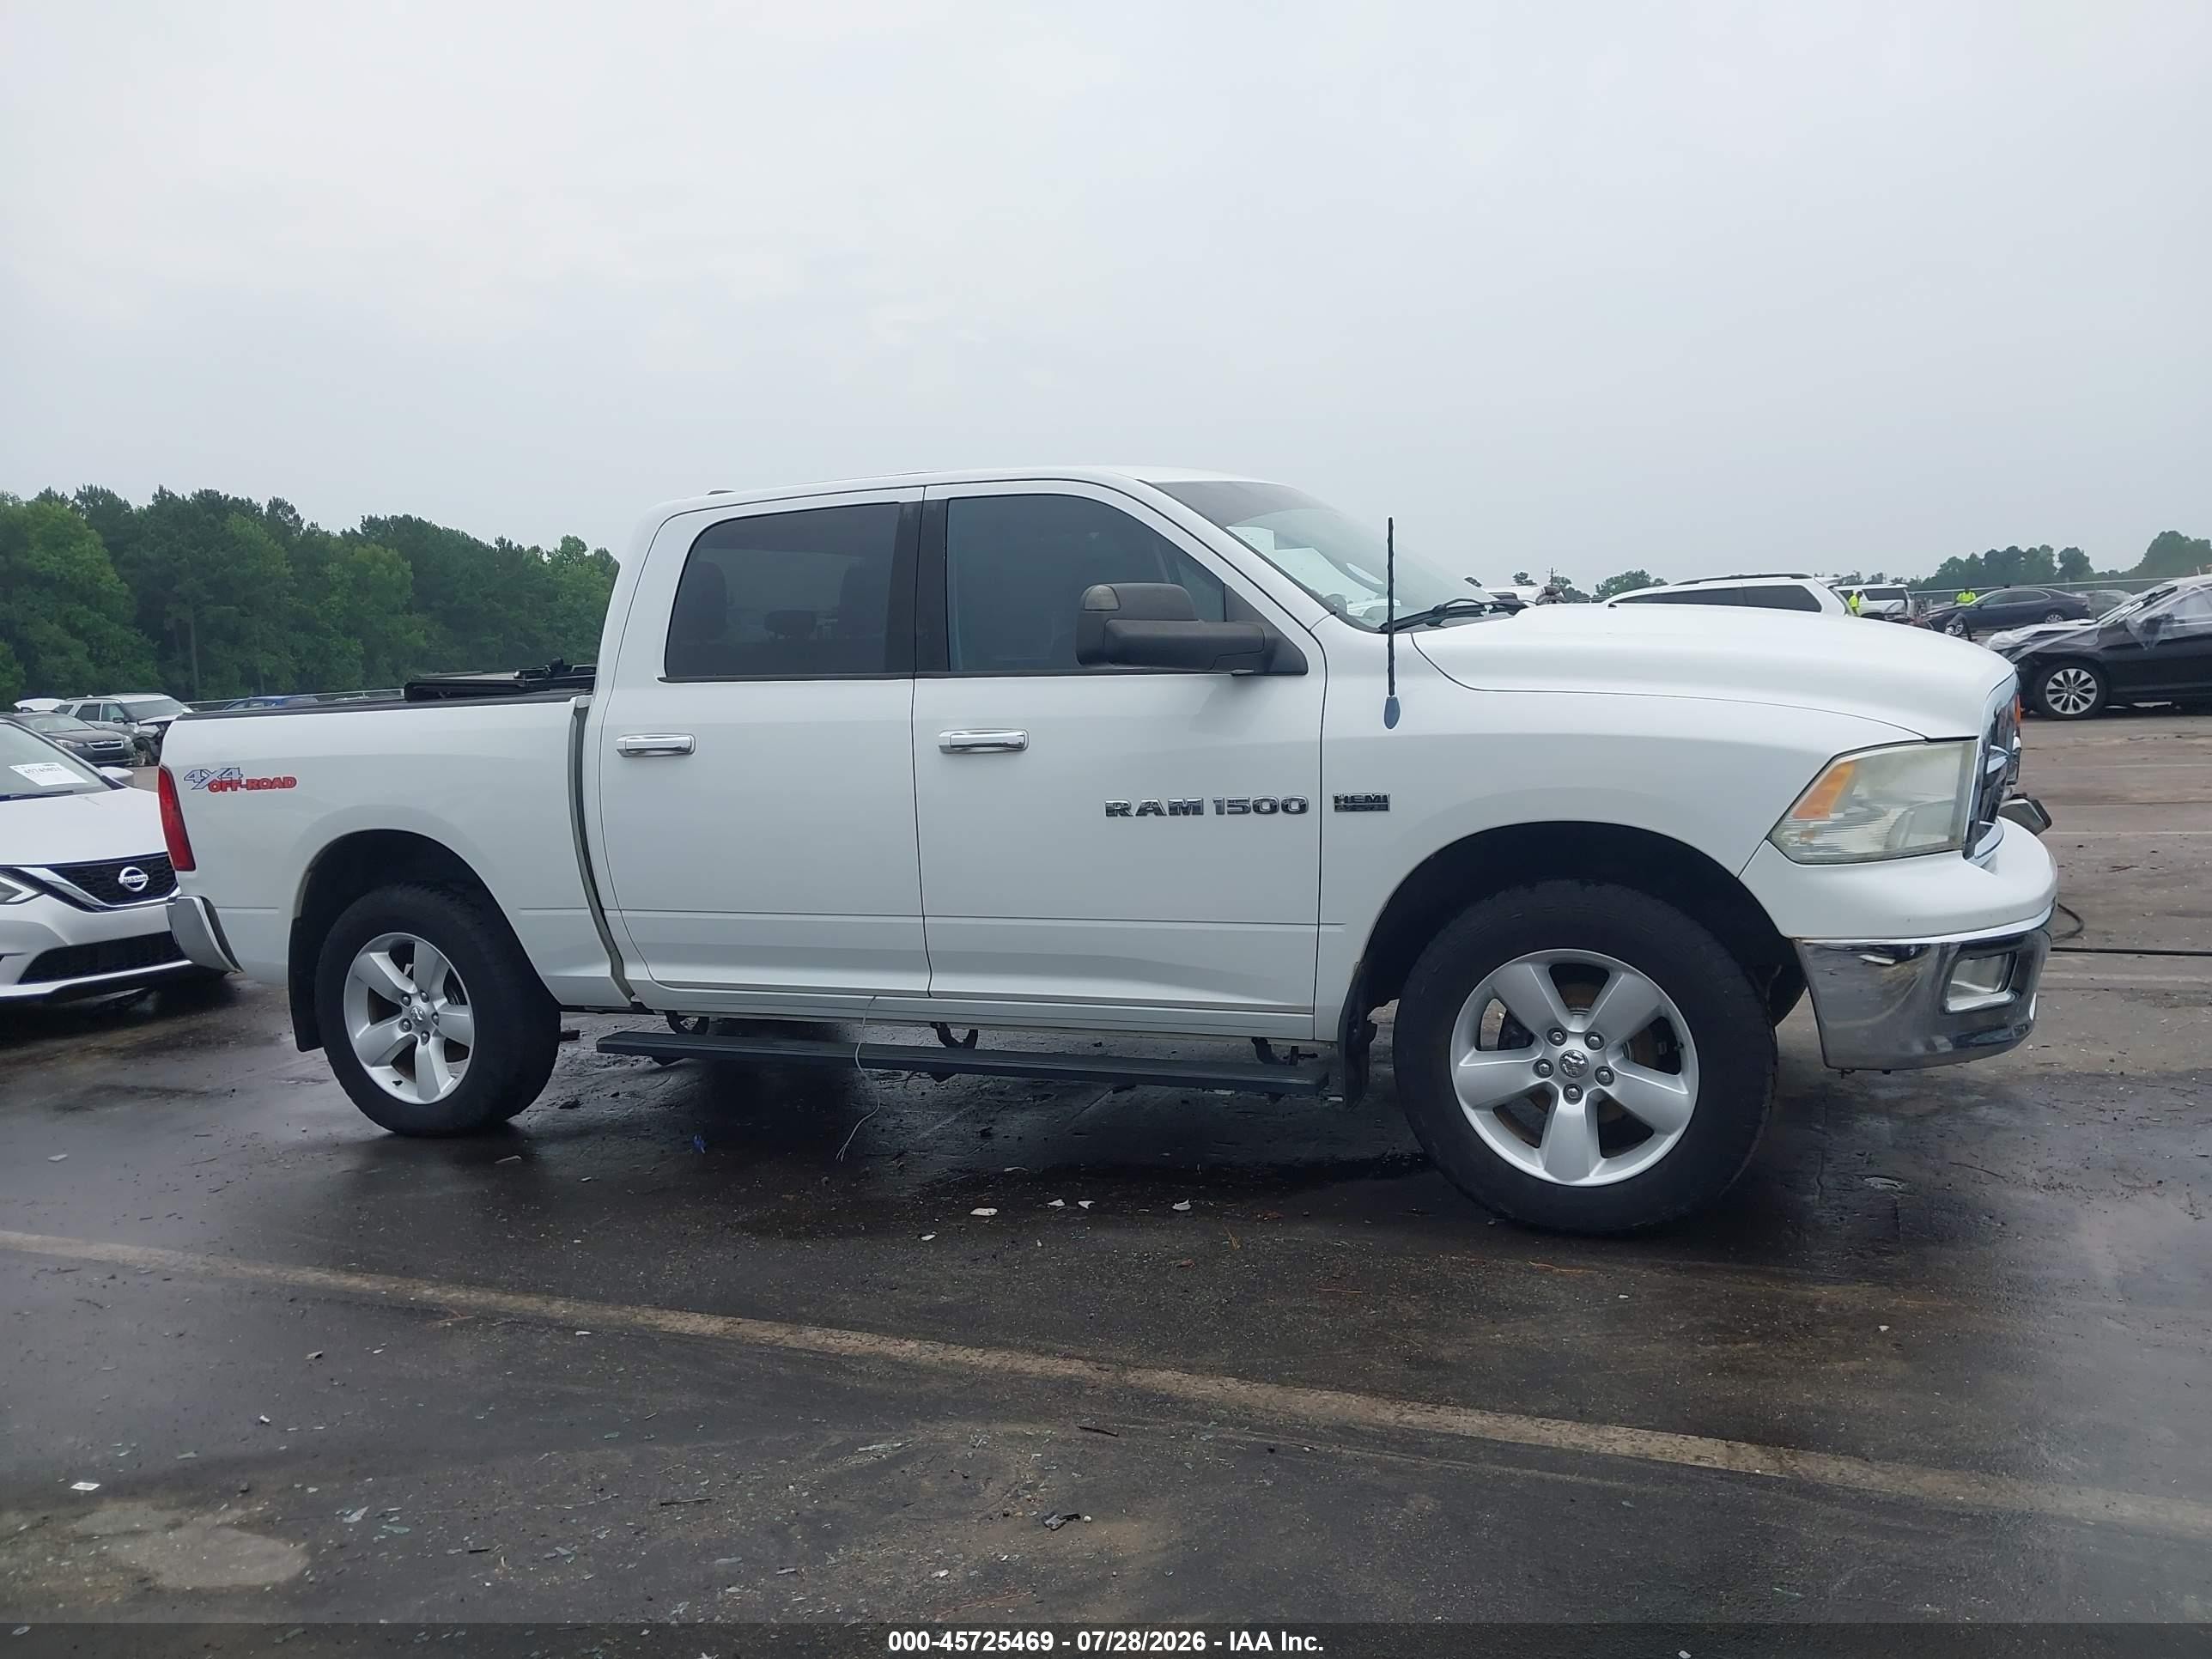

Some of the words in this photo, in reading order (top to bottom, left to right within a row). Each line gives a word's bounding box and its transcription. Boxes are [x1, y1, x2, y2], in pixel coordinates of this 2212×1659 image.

[207, 776, 297, 793] OFF-ROAD
[1105, 799, 1204, 817] RAM
[1212, 796, 1310, 816] 1500
[1334, 793, 1389, 804] HEMI
